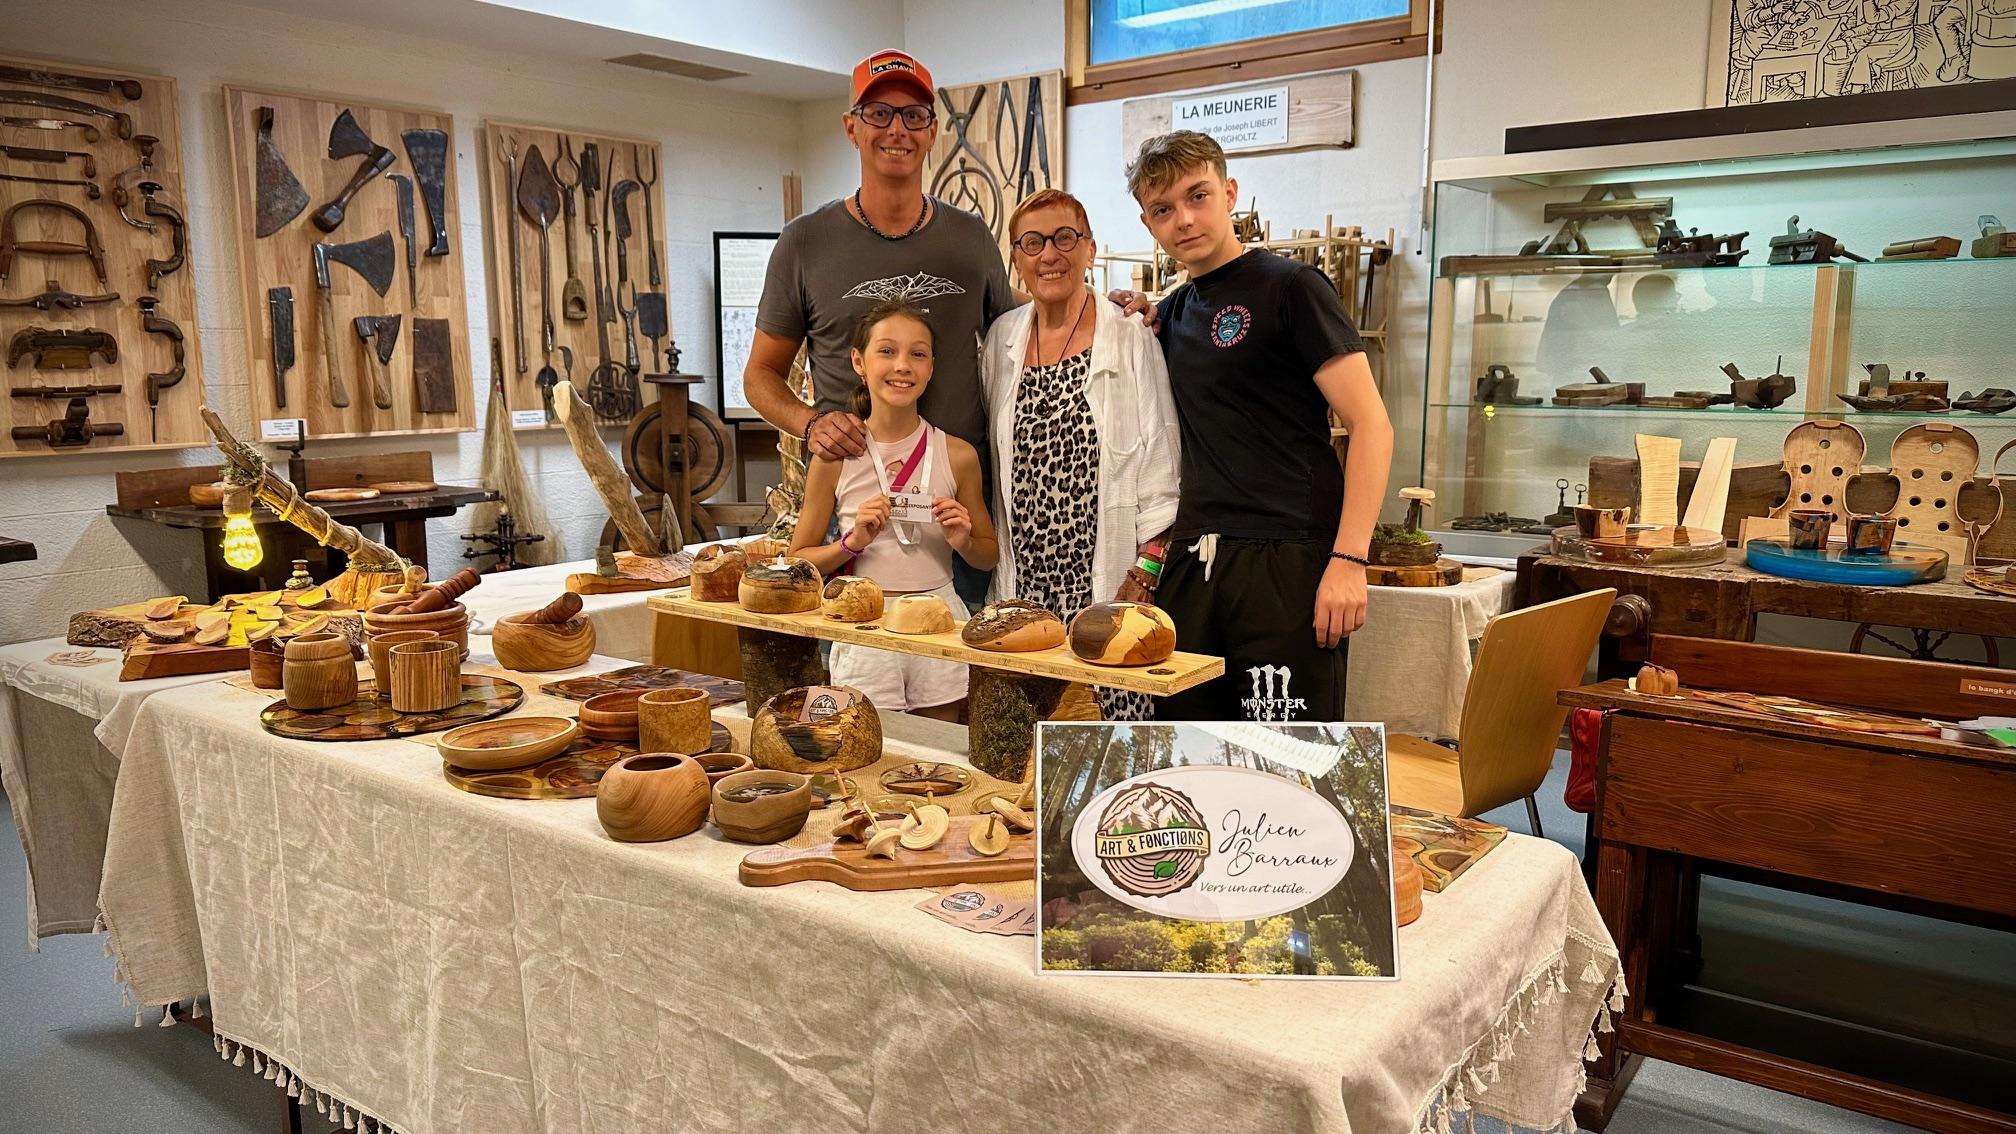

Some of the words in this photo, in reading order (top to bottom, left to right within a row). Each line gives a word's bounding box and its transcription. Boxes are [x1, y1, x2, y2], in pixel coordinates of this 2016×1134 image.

[872, 66, 884, 74] LA
[886, 64, 914, 73] GRAVE
[1182, 105, 1200, 119] LA
[1203, 94, 1278, 117] MEUNERIE
[1213, 124, 1222, 133] de
[1223, 121, 1249, 134] Joseph
[1250, 117, 1278, 129] LIBERT
[1216, 132, 1257, 144] ERGHOLTZ
[1212, 305, 1232, 330] SPEED
[1233, 304, 1251, 328] WHEELS
[1210, 331, 1227, 348] SANTA
[1227, 329, 1248, 348] CRUZ
[1978, 685, 2004, 695] bangk
[1218, 809, 1306, 854] Julien
[1100, 840, 1123, 855] ART
[1127, 838, 1137, 853] &
[1226, 837, 1338, 877] Barraux
[1200, 881, 1226, 893] Vers
[1228, 884, 1248, 893] un
[1248, 883, 1271, 893] art
